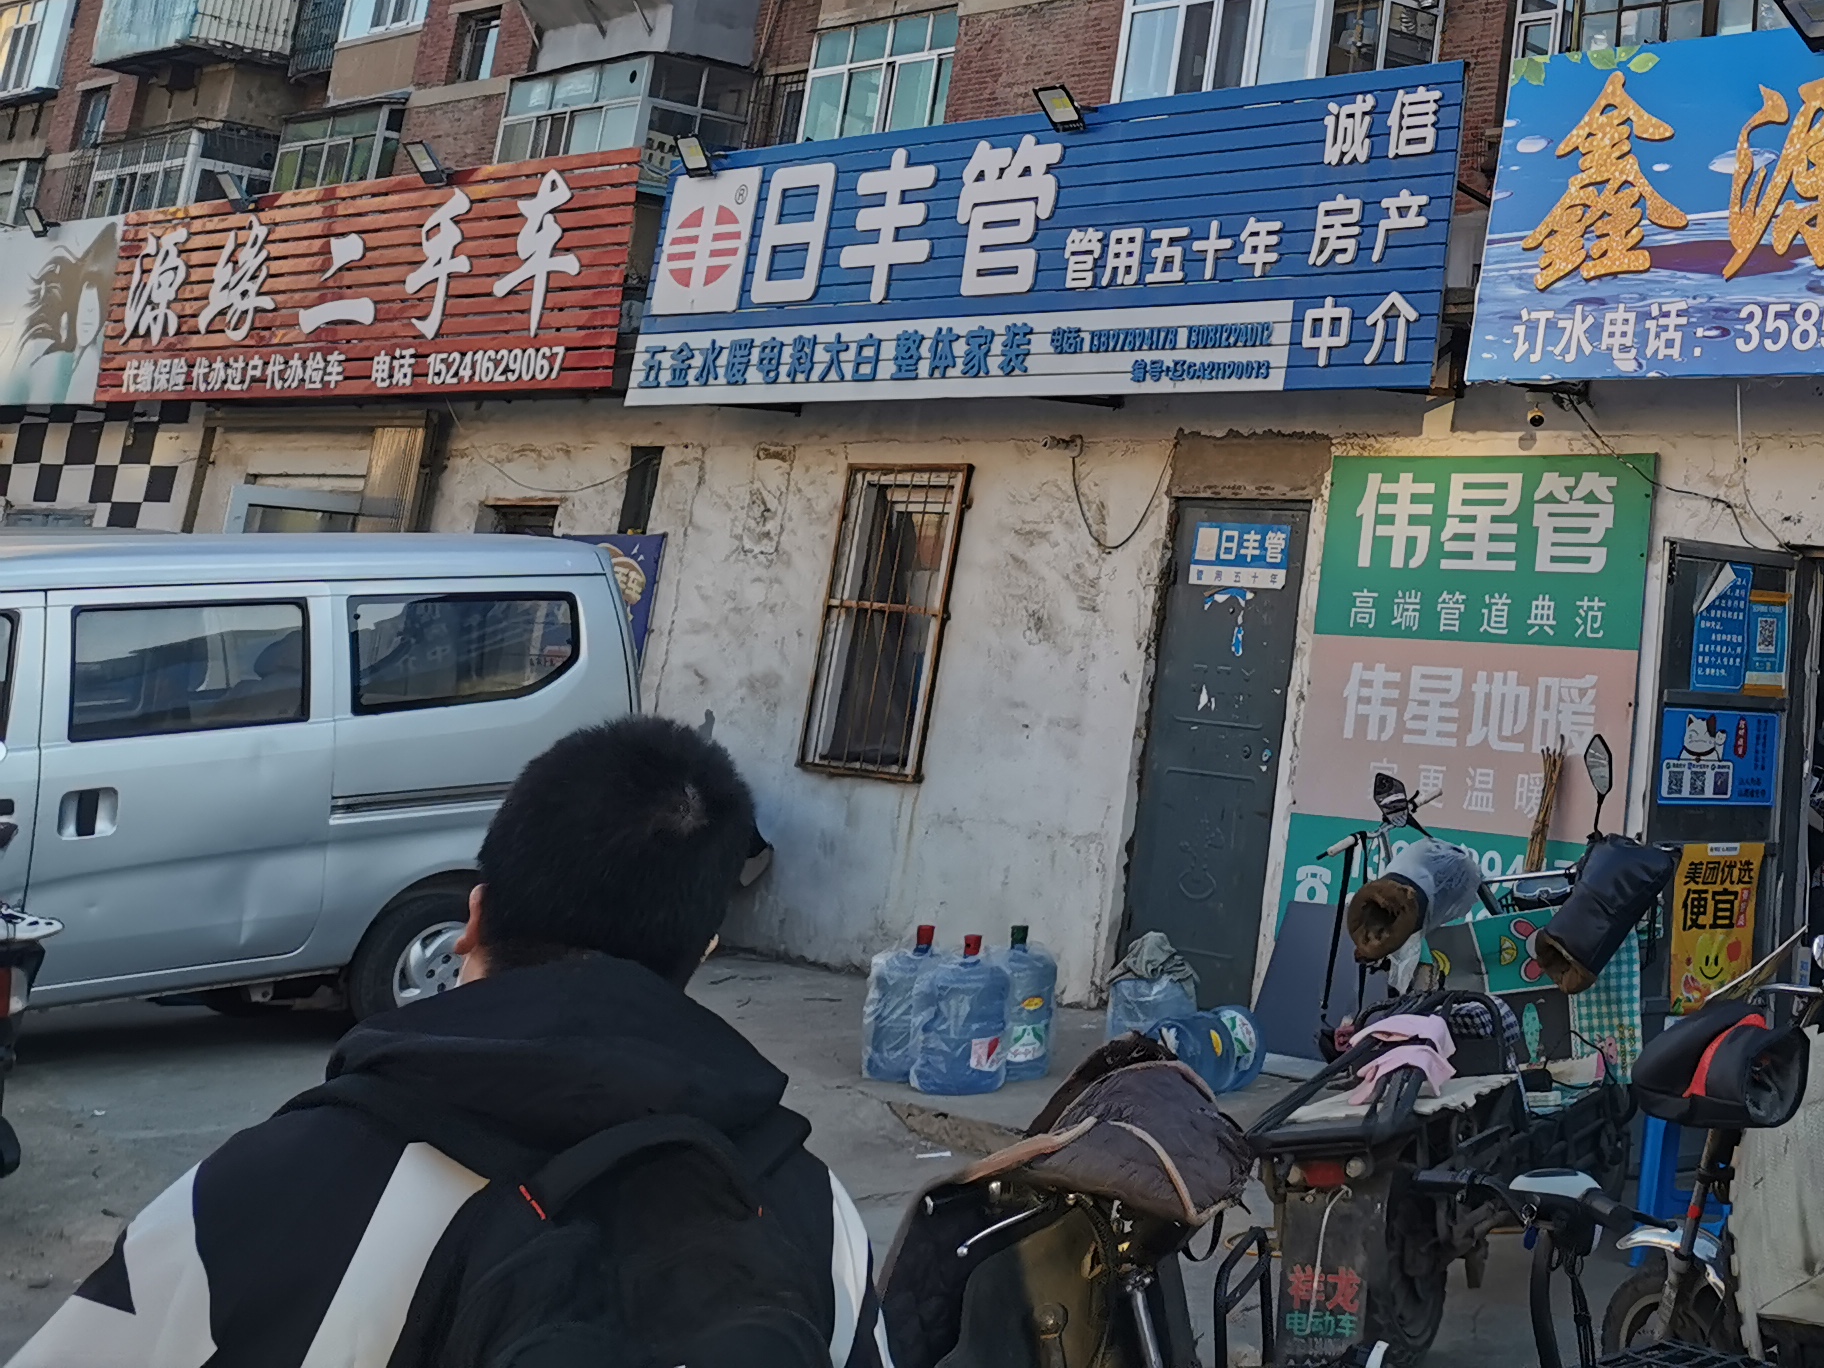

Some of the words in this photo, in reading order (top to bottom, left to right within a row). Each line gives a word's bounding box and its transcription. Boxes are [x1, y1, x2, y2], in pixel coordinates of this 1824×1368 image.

[1323, 86, 1443, 166] 诚信
[750, 134, 1066, 305] 日丰管
[1309, 188, 1431, 268] 房产
[119, 168, 581, 346] 源缘二手车
[1064, 218, 1284, 292] 管用五十年
[639, 330, 883, 389] 五金水暖电料大白
[890, 323, 1032, 381] 整体家装
[1088, 327, 1178, 353] 13897894178
[1302, 290, 1420, 368] 中介
[192, 355, 262, 391] 代办过户
[265, 351, 347, 390] 代办检车
[370, 349, 416, 387] 电话
[426, 346, 565, 385] 15241629067
[1220, 530, 1287, 563] 日丰管
[1355, 471, 1618, 574] 伟星管
[1349, 588, 1607, 639] 高端管道典范
[1342, 662, 1599, 757] 伟星地暖
[1683, 859, 1754, 886] 美团优选
[1682, 888, 1739, 931] 便宜
[1285, 1310, 1358, 1337] 电动车
